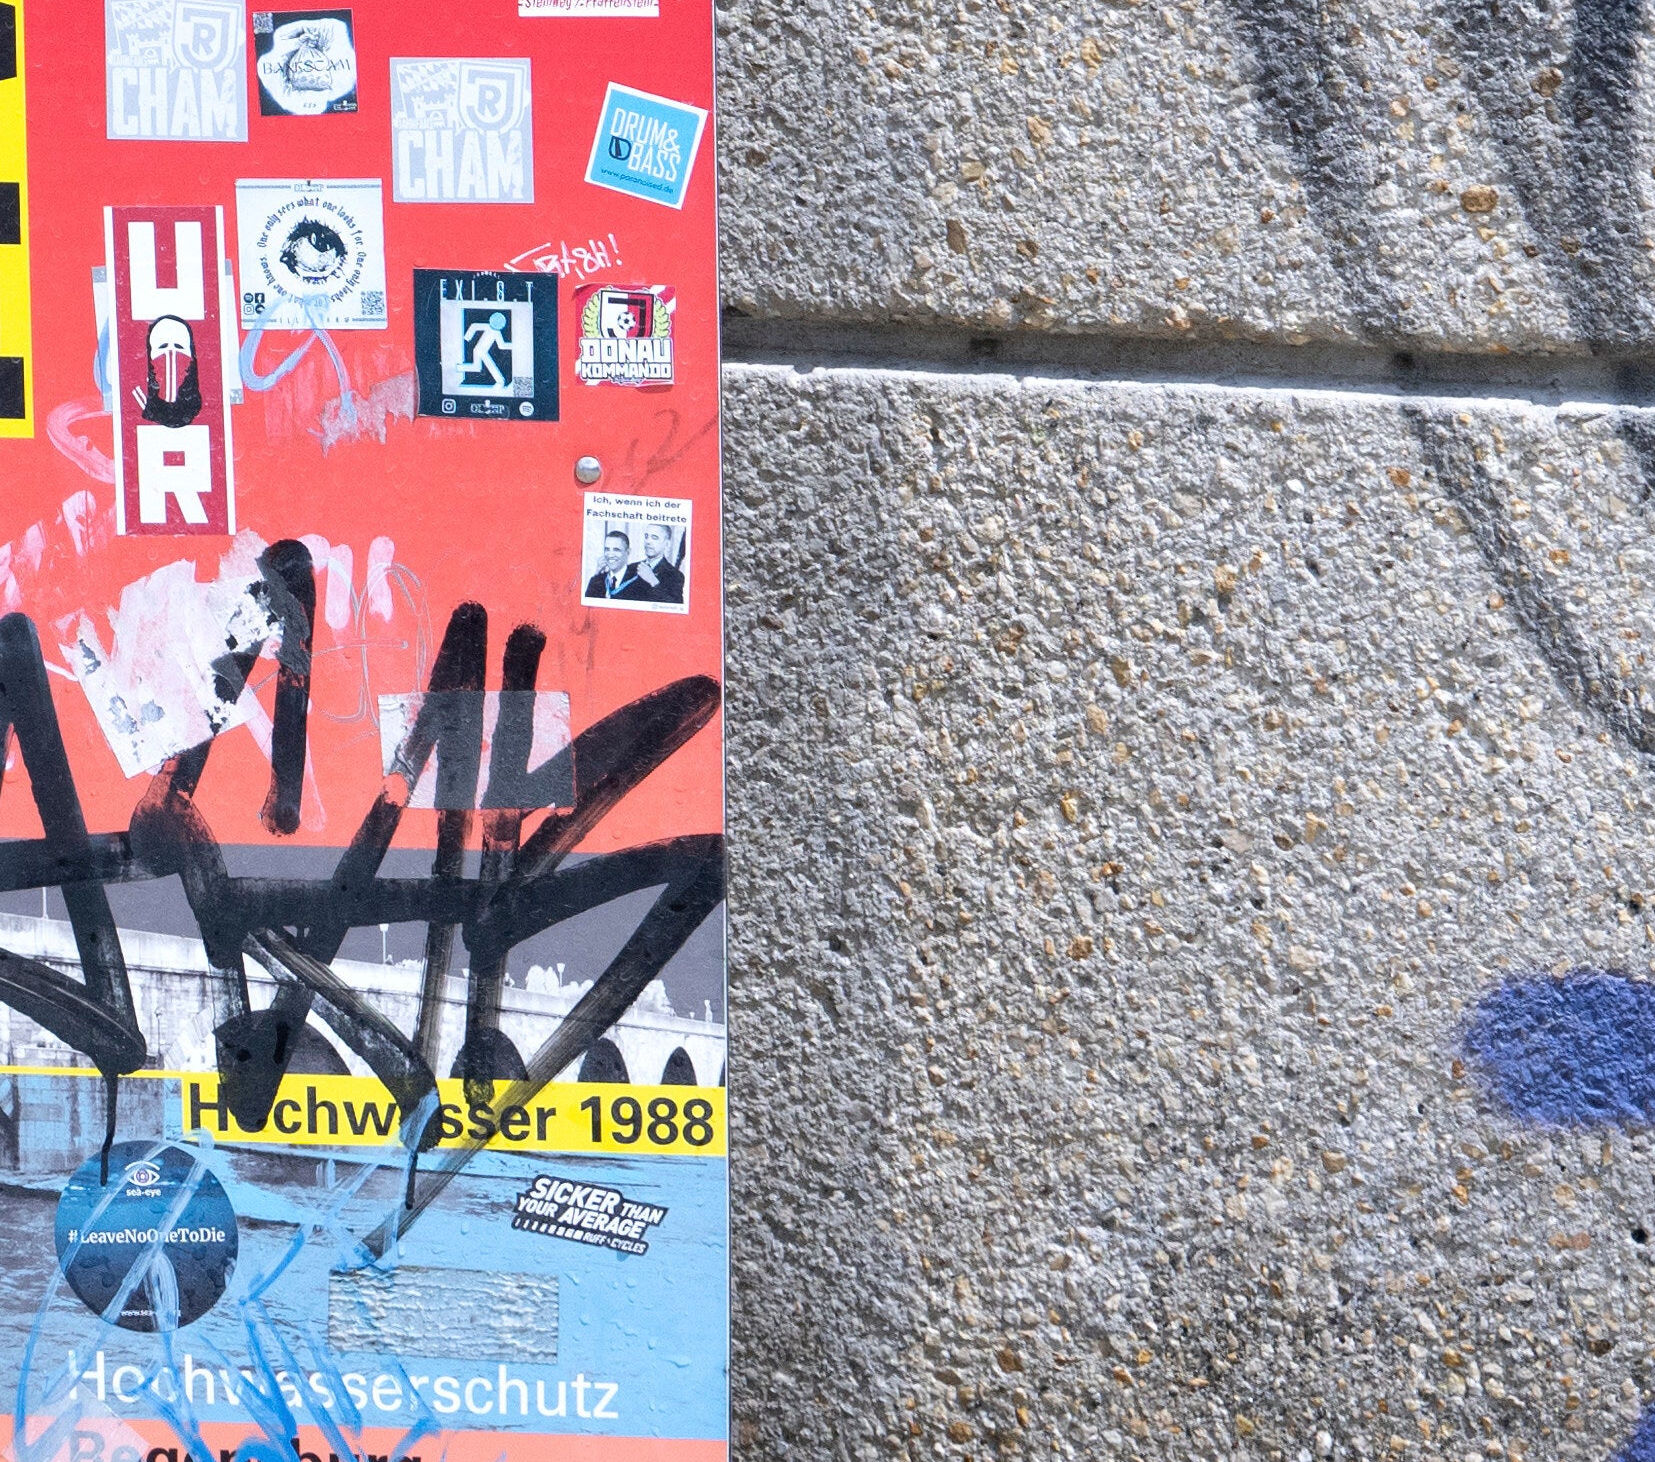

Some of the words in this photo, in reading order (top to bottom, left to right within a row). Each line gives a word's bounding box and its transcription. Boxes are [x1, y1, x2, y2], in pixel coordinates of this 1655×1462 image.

[112, 68, 238, 137] CHAM
[397, 130, 523, 198] CHAM
[627, 142, 681, 182] BASS
[580, 339, 671, 363] DONAU
[581, 363, 672, 379] KOMMANDO
[586, 509, 643, 520] Fachschaft
[646, 513, 687, 523] beitrete
[593, 495, 612, 505] Ich,
[615, 499, 642, 507] wenn
[646, 499, 661, 508] ich
[664, 501, 681, 509] der
[189, 1083, 555, 1142] Hchwsser
[580, 1095, 715, 1146] 1988
[126, 1188, 162, 1197] sea-eye
[530, 1177, 620, 1213] SICKER
[619, 1202, 664, 1223] THAN
[517, 1196, 559, 1217] YOUR
[558, 1206, 646, 1238] AVERAGE
[610, 1240, 647, 1254] CYCLES
